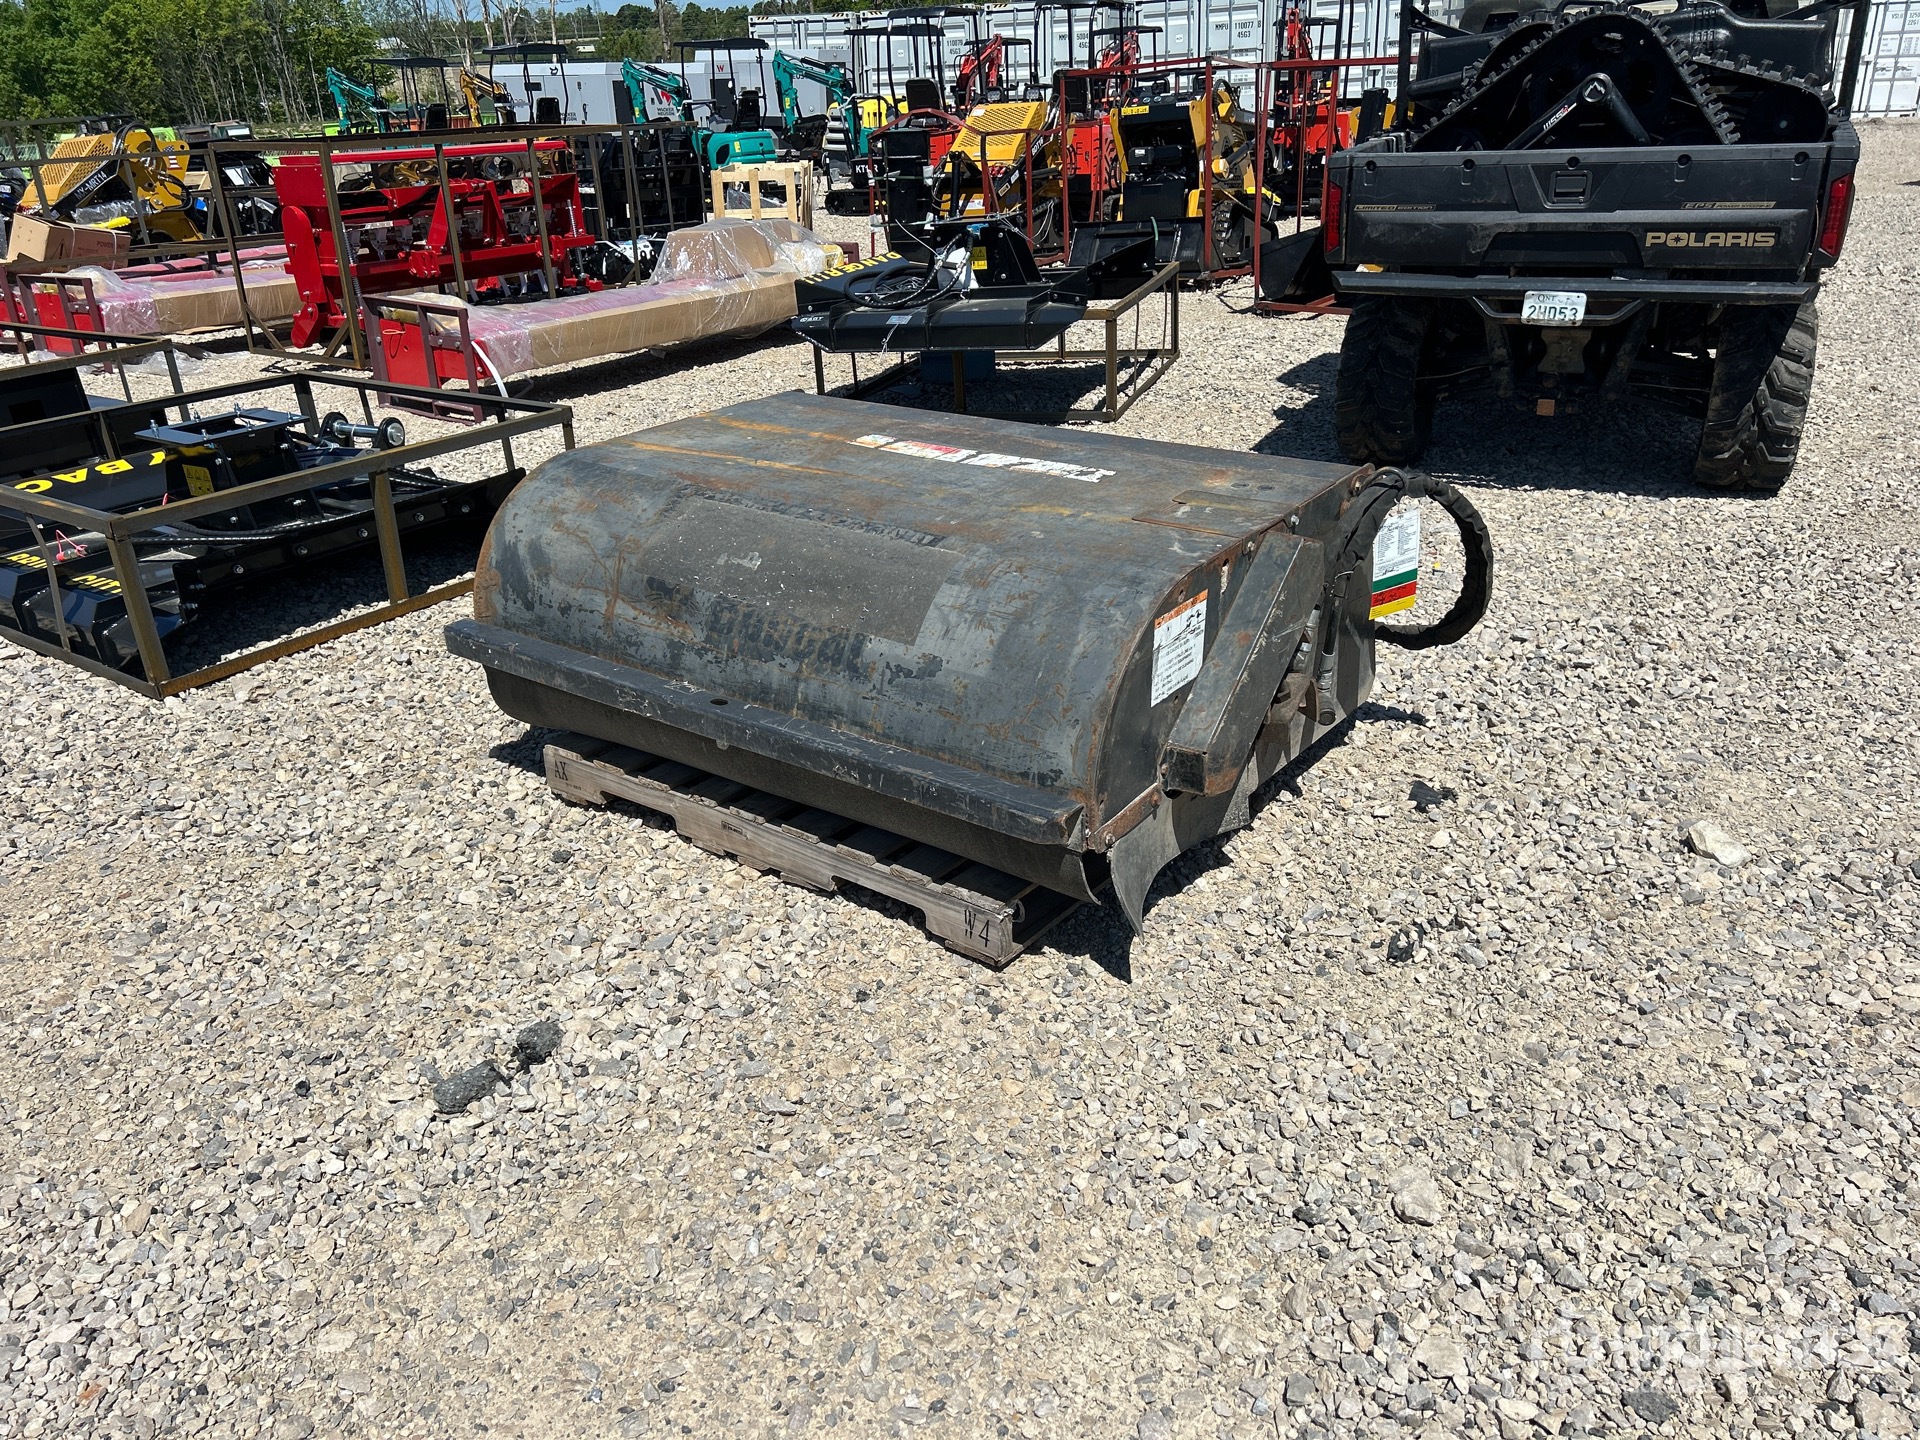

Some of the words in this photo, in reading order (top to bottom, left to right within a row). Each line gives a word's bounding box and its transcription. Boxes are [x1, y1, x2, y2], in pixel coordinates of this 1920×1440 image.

[1234, 21, 1254, 30] 110077
[855, 164, 878, 173] KT1R
[1645, 231, 1776, 248] POLARIS
[96, 240, 114, 249] POWER
[554, 760, 569, 782] AX
